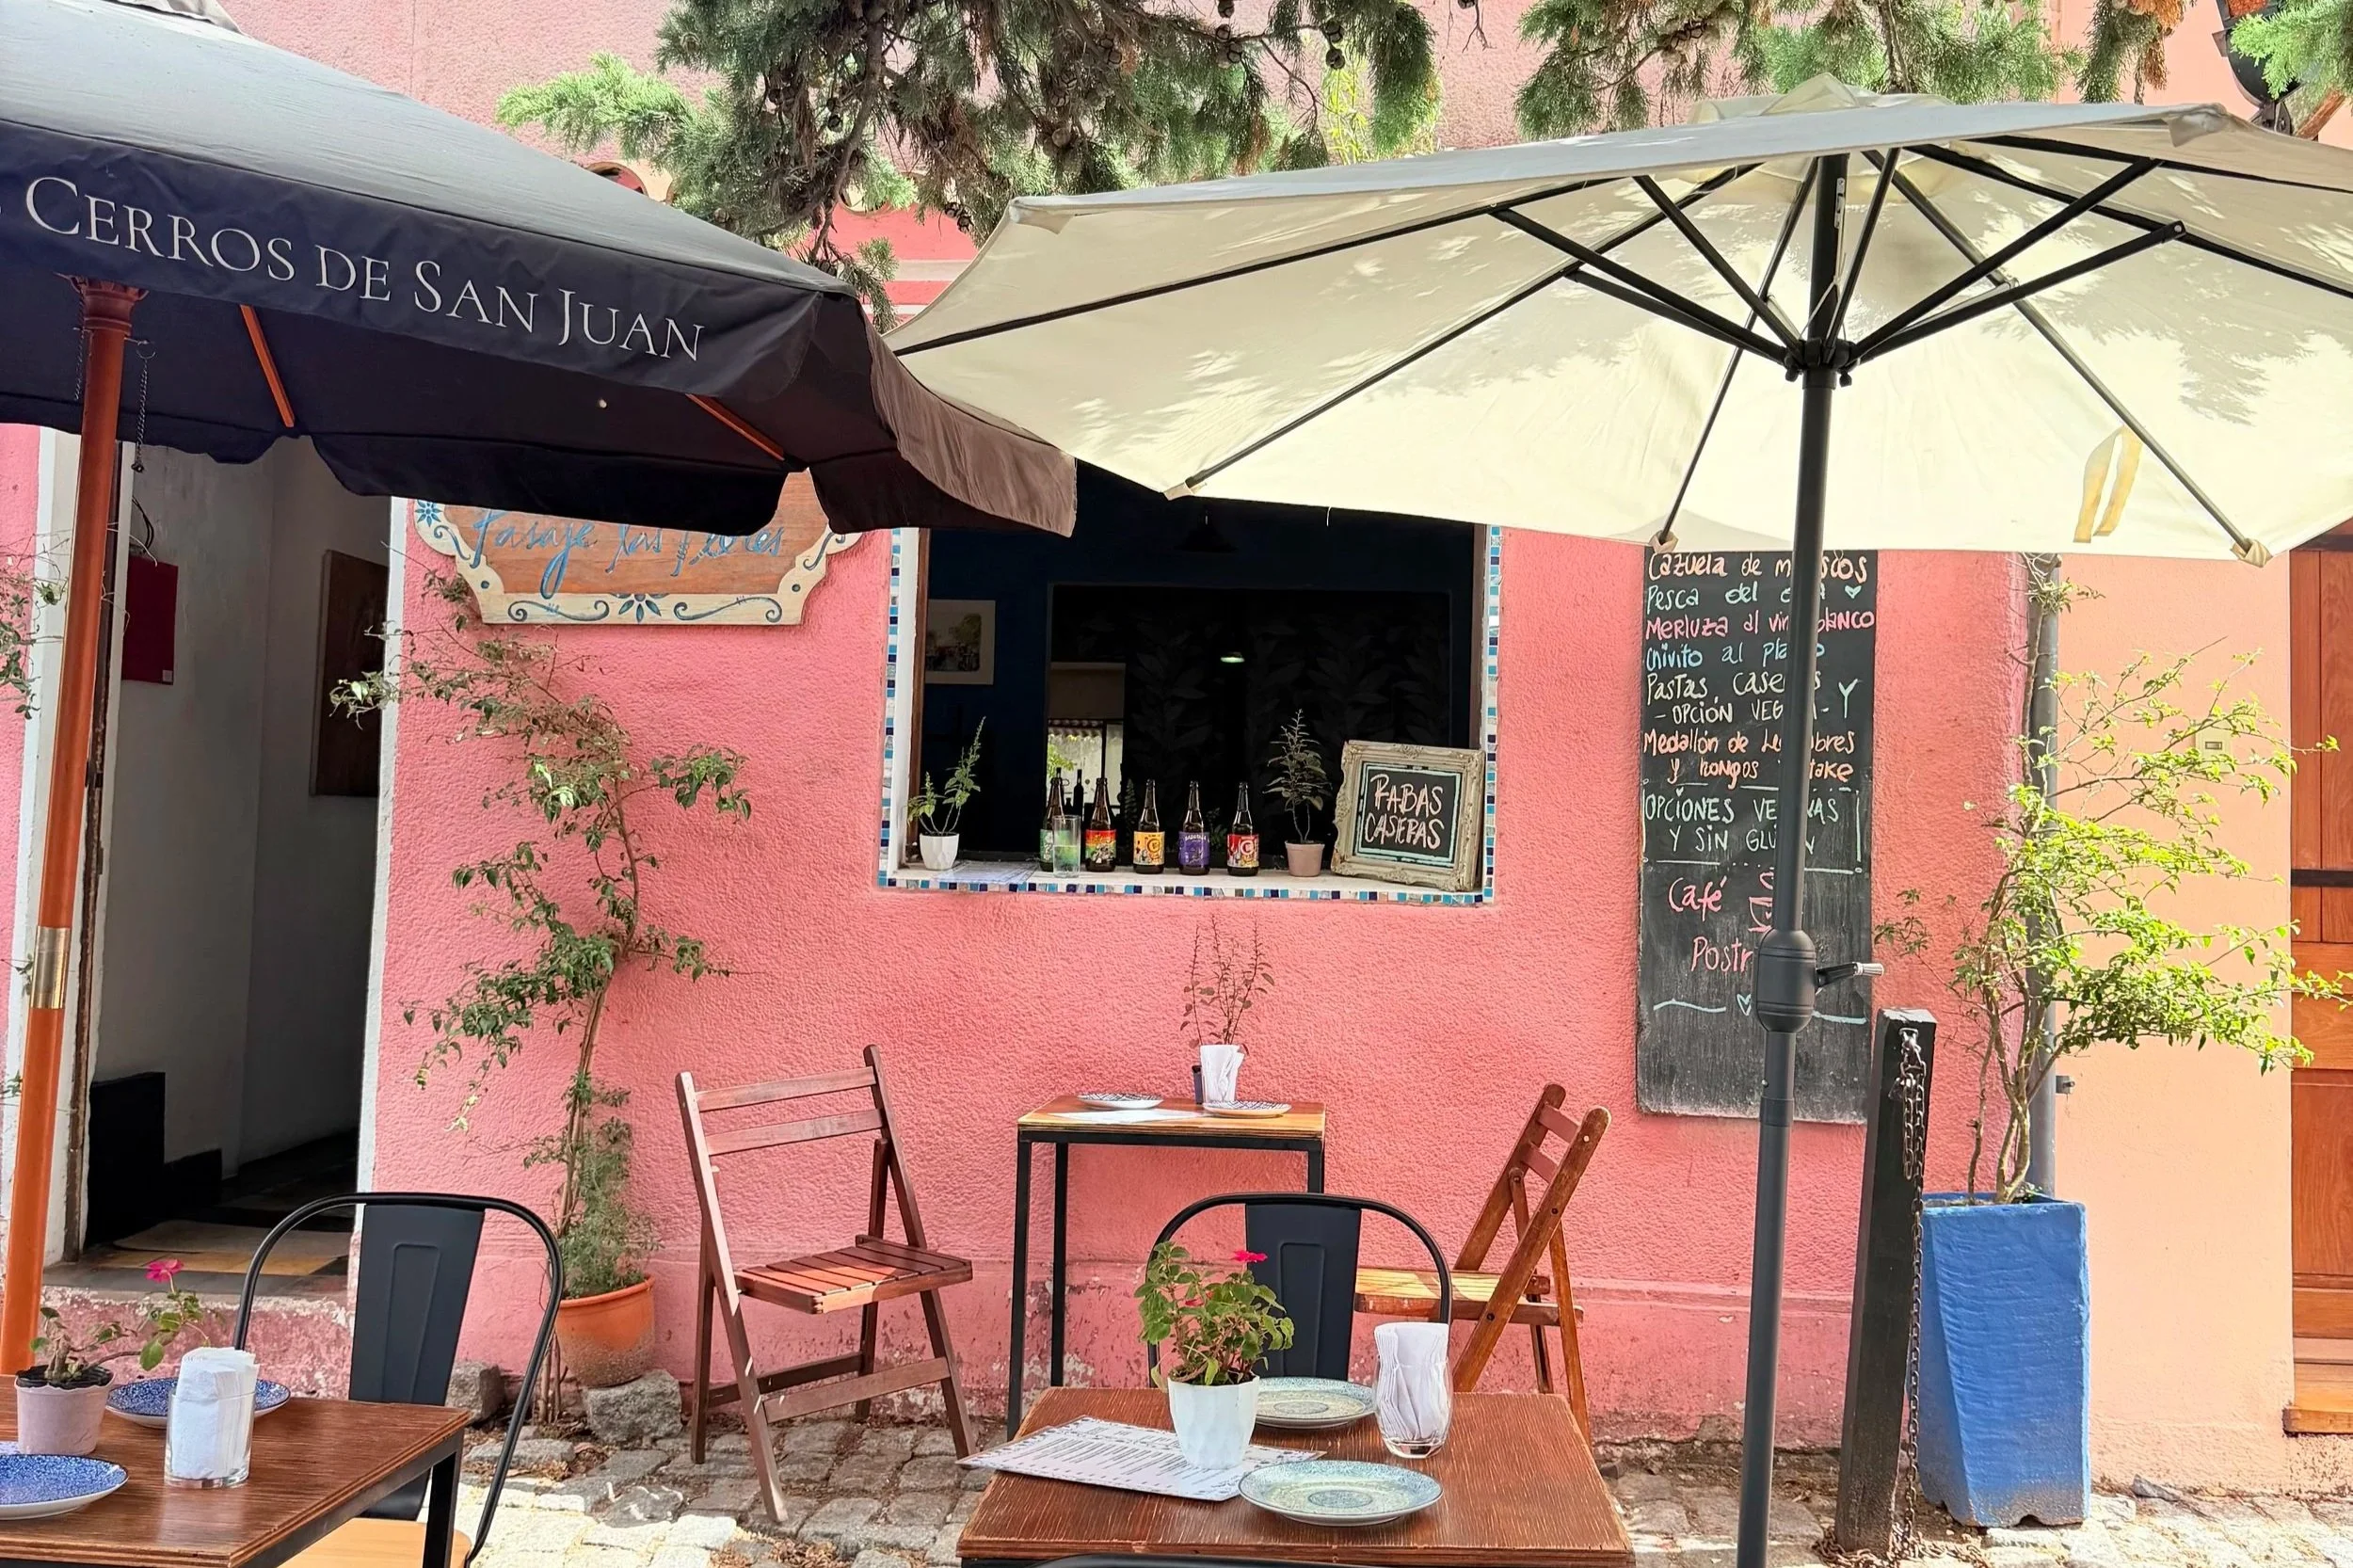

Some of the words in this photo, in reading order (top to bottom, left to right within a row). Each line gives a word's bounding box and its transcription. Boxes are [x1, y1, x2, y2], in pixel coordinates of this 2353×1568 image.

[25, 176, 296, 281] CERROS
[314, 244, 392, 302] DE
[412, 260, 539, 333] SAN
[557, 288, 706, 361] JUAN
[1741, 552, 1762, 577] de
[1775, 555, 1868, 584] mscos
[1646, 584, 1699, 615] Pesca
[1724, 581, 1758, 604] del
[1769, 610, 1790, 632] vin
[1721, 641, 1744, 664] al
[1763, 637, 1826, 667] plao
[1733, 670, 1822, 696] Cases
[1643, 728, 1720, 757] Medallón
[1728, 730, 1750, 754] de
[1761, 728, 1856, 755] Lebres
[1370, 774, 1444, 818] RABAS
[1667, 875, 1728, 922] Café
[1690, 936, 1754, 972] Postr
